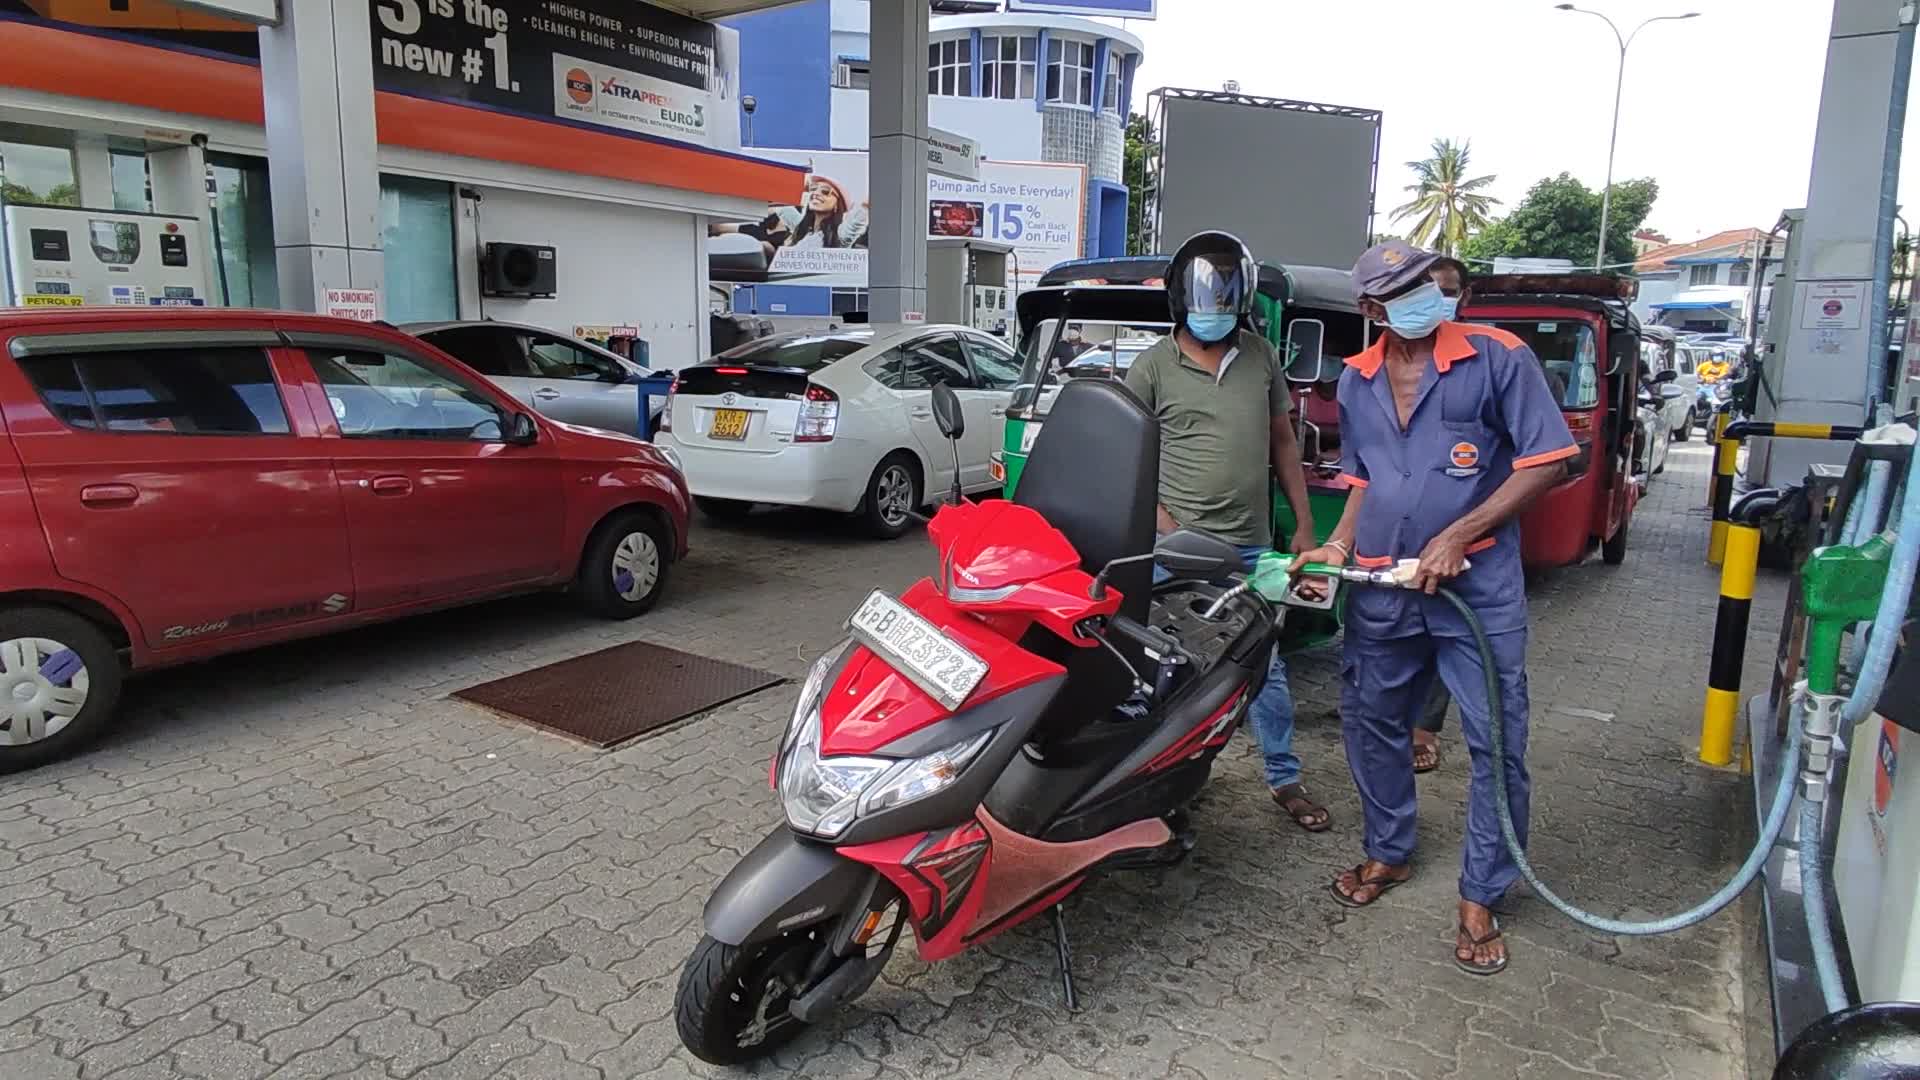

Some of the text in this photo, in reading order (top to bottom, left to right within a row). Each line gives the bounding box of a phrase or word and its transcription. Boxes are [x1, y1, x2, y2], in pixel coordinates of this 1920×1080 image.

[463, 0, 508, 33] the
[550, 2, 622, 33] HIGHER POWER
[531, 16, 616, 49] CLEANER ENGINE
[636, 26, 680, 49] SUPERIOR
[381, 37, 453, 78] new
[629, 43, 689, 70] ENVIRONMENT
[929, 179, 1074, 198] Pump and Save Everyday!
[987, 203, 1023, 240] 15
[1025, 231, 1071, 243] on Fuel
[780, 250, 795, 259] LIFE
[796, 251, 805, 259] IS
[806, 251, 825, 260] BEST
[826, 252, 851, 261] WHEN
[774, 261, 860, 272] DRIVES YOU FURTHER
[26, 297, 82, 306] PETROL 92
[328, 291, 375, 304] NO SMOKING
[331, 308, 374, 320] SWITCH OFF
[613, 327, 636, 336] SERVO
[713, 422, 739, 436] 5612
[954, 563, 979, 585] NDA
[163, 619, 229, 640] Racing
